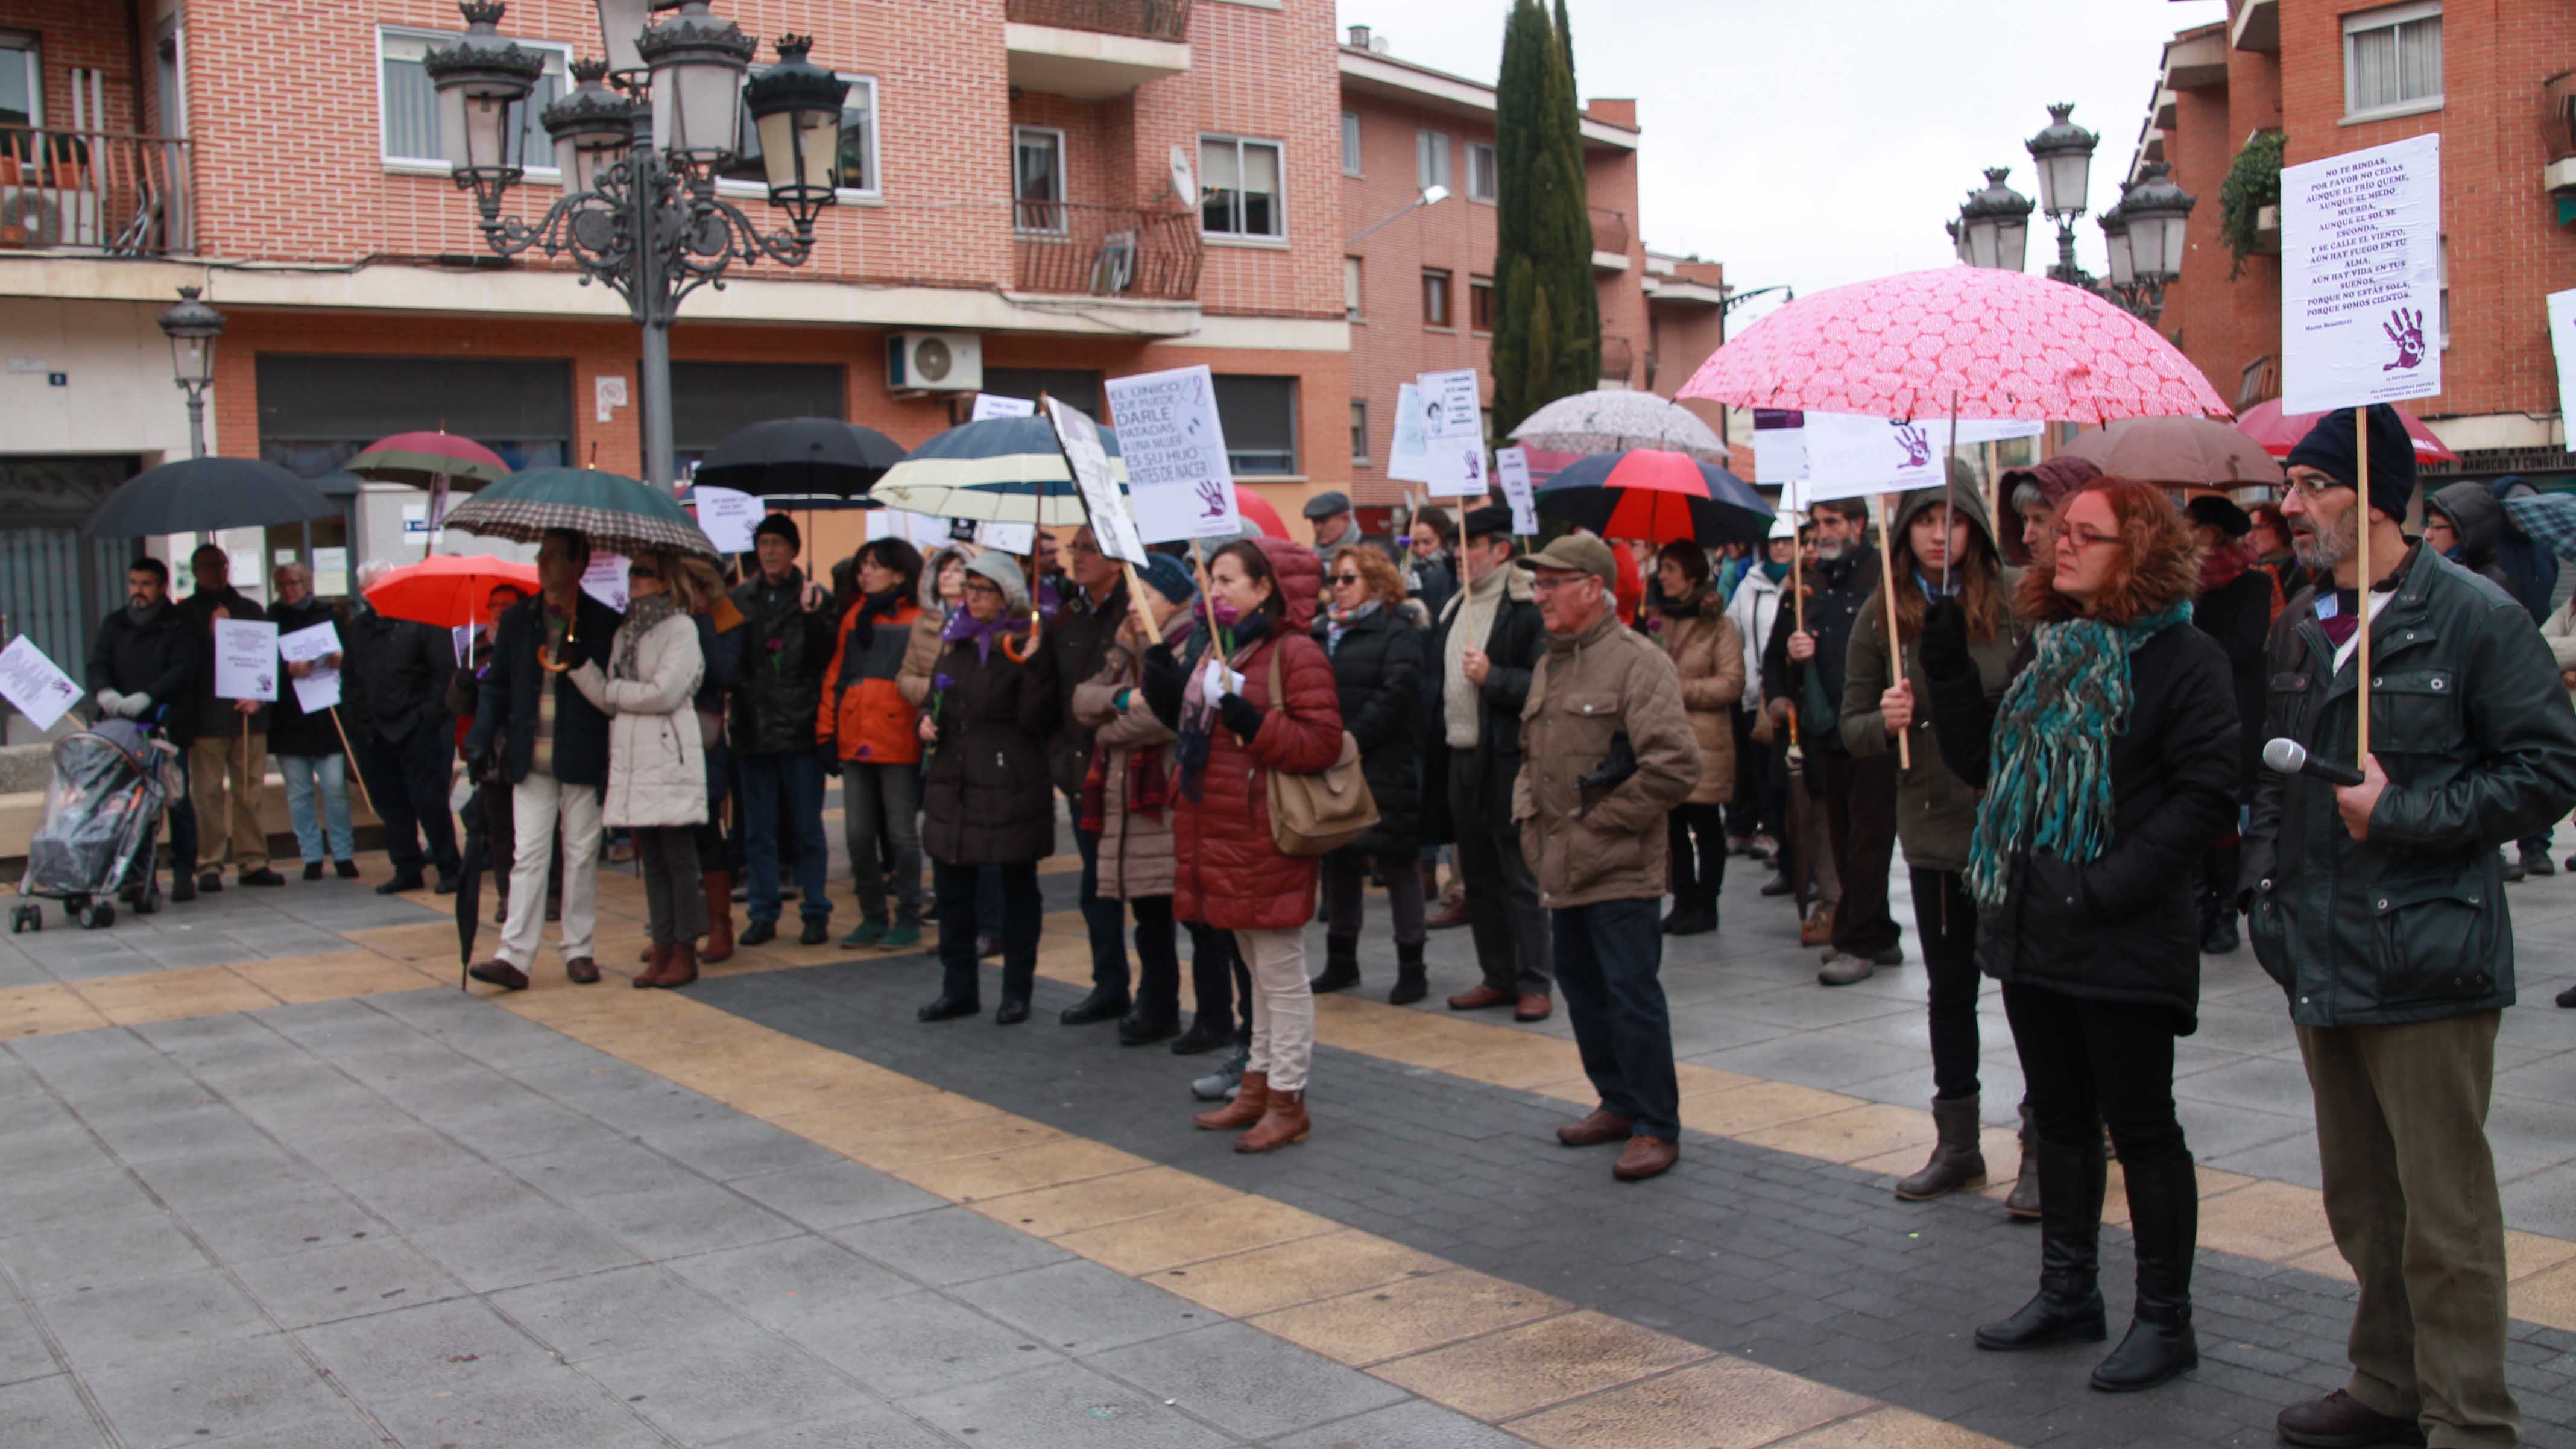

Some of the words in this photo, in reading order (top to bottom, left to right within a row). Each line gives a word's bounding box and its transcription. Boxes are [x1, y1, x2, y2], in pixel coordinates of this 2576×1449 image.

[2311, 182, 2327, 191] POR
[2330, 175, 2358, 188] FAVOR
[2361, 171, 2372, 179] NO
[2375, 164, 2404, 176] CEDAS
[2326, 169, 2337, 178] NO
[2340, 165, 2350, 174] TE
[2306, 190, 2341, 203] AUNQUE
[2355, 181, 2374, 192] FRÍO
[2319, 197, 2353, 210] AUNQUE
[2369, 188, 2396, 198] MIEDO
[2319, 218, 2353, 232] AUNQUE
[2368, 210, 2384, 219] SOL
[2331, 239, 2355, 250] CALLE
[2310, 254, 2328, 264] AÚN
[2331, 250, 2347, 259] HAY
[2350, 245, 2378, 256] FUEGO
[2311, 275, 2329, 285] AÚN
[2331, 271, 2349, 280] HAY
[2351, 267, 2372, 276] VIDA
[2389, 260, 2405, 268] TUS
[2308, 294, 2341, 306] PORQUE
[2357, 285, 2382, 297] ESTÁS
[2307, 305, 2340, 317] PORQUE
[2342, 299, 2370, 310] SOMOS
[2324, 318, 2352, 329] Benedetti
[1117, 407, 1171, 425] DARLE
[1119, 423, 1176, 437] PATADAS
[1144, 452, 1163, 466] SU
